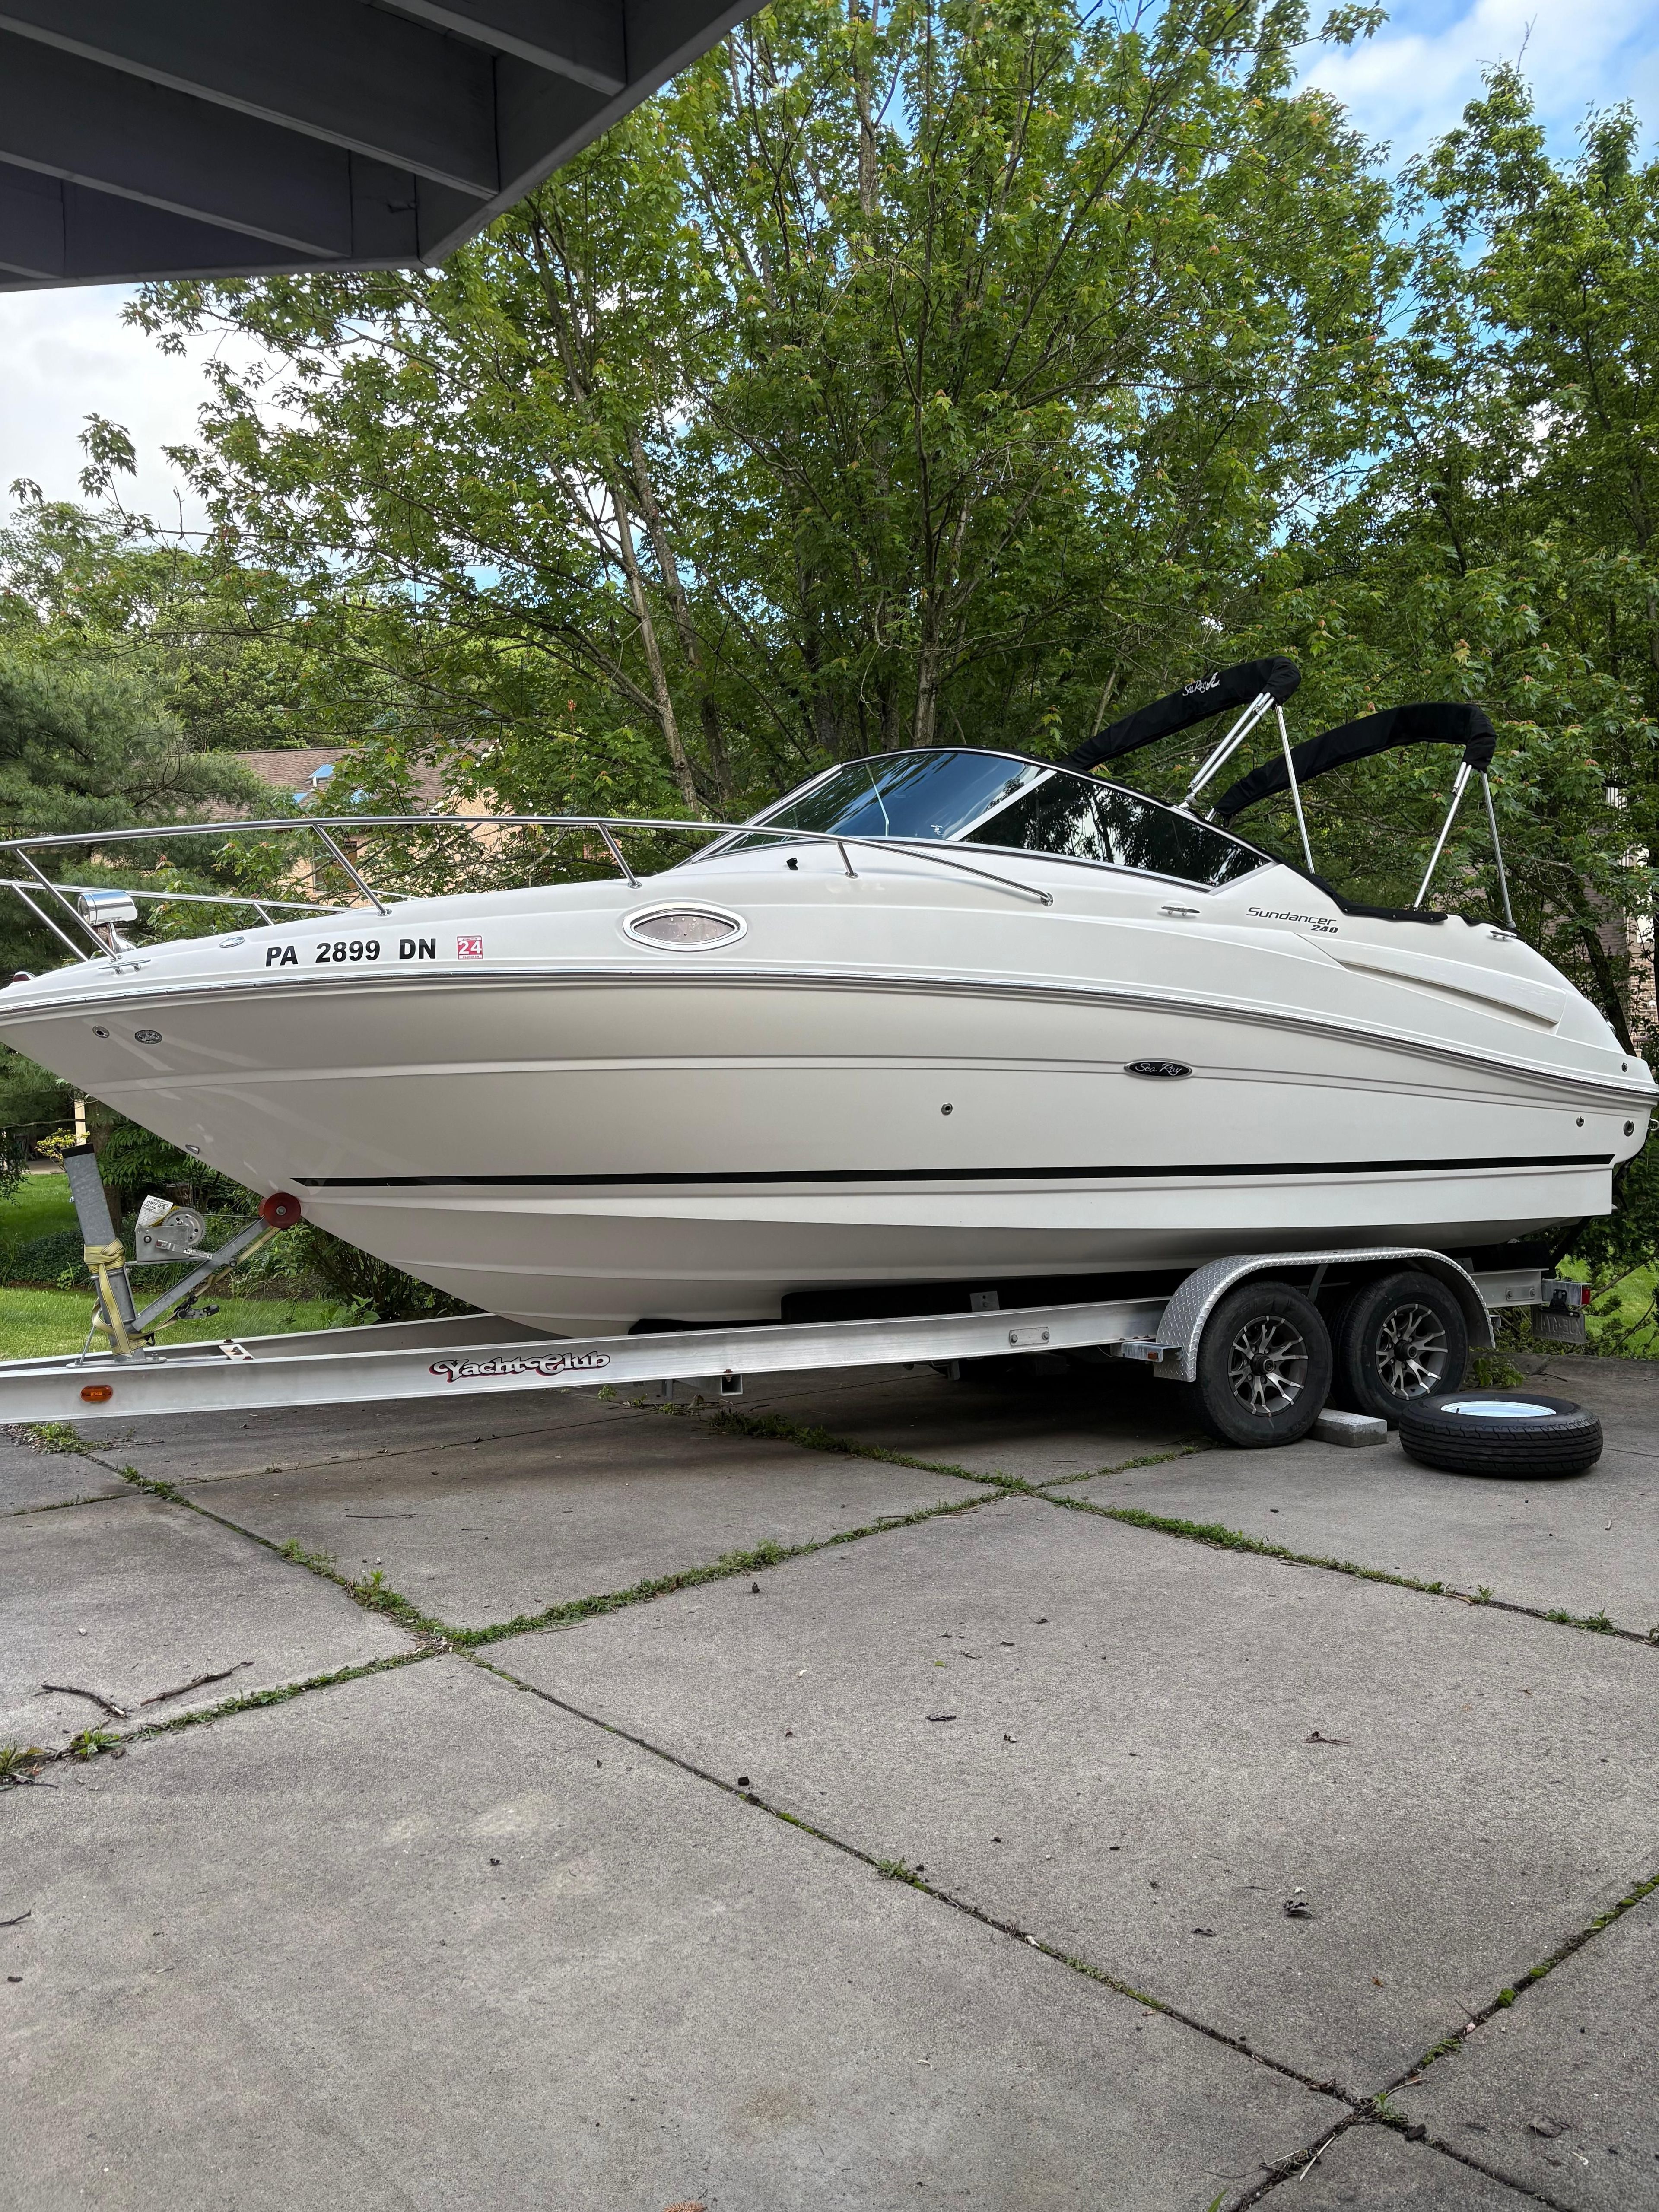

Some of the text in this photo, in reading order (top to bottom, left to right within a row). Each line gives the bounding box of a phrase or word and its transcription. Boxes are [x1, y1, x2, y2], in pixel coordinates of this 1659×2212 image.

[1246, 907, 1337, 925] Sundancer
[1310, 925, 1339, 933] 240
[266, 938, 436, 967] PA 2899 DN
[458, 940, 482, 955] 24
[1135, 1063, 1182, 1076] Sea Ray
